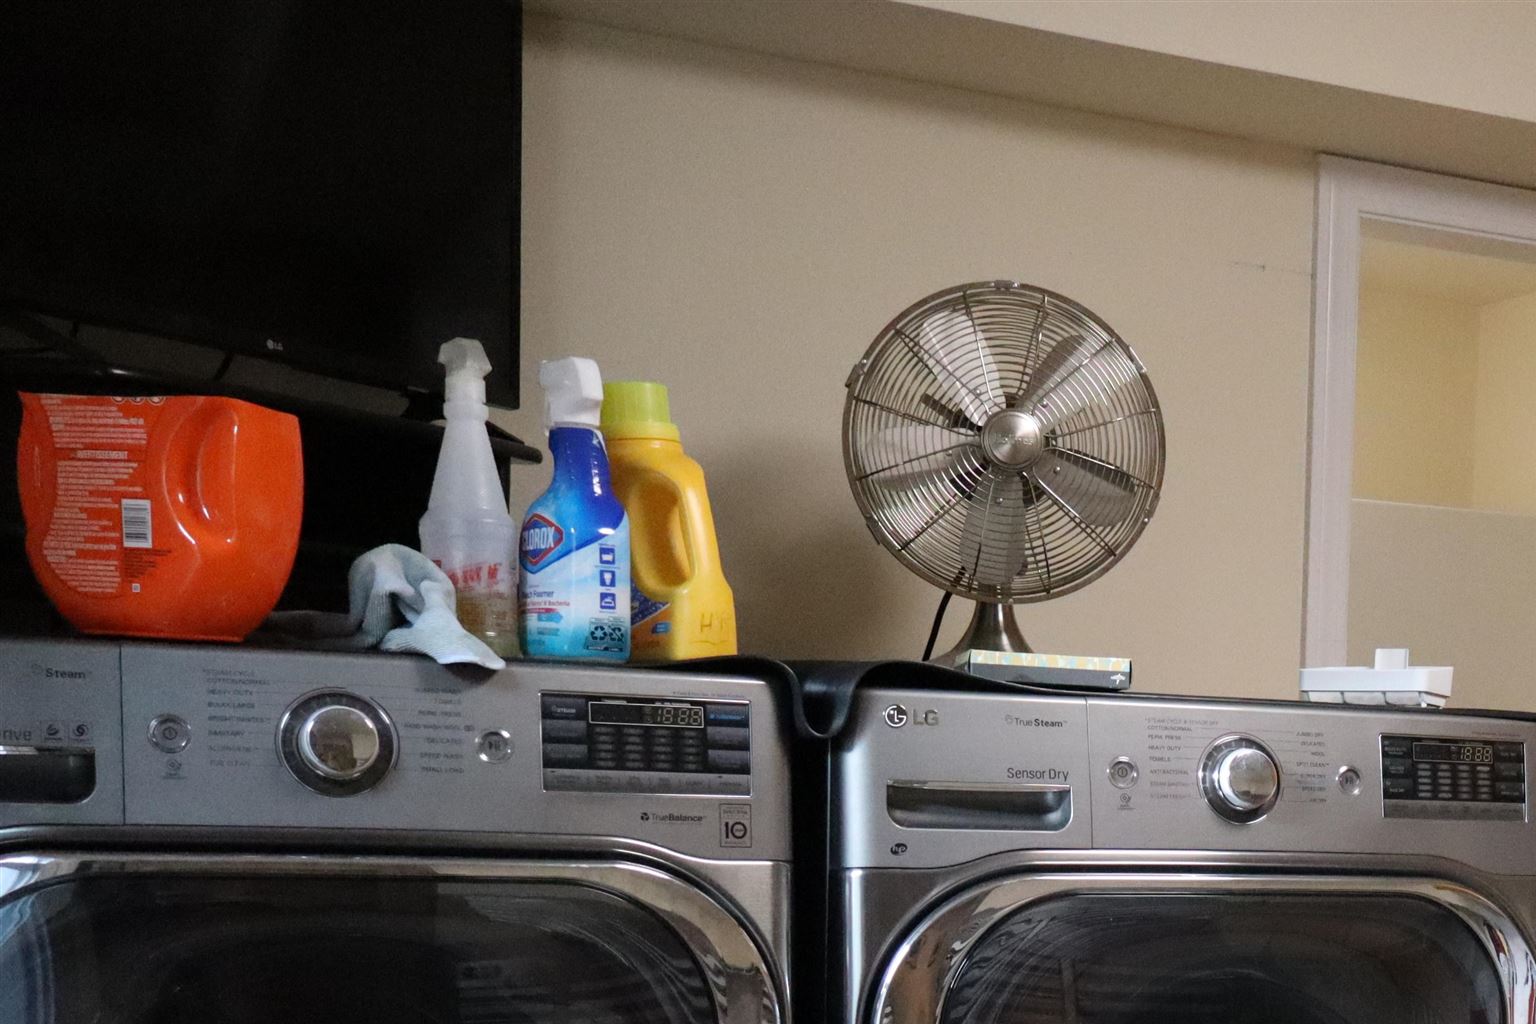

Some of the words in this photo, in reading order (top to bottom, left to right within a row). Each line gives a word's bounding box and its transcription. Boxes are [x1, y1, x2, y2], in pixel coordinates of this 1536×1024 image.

[912, 708, 939, 726] LG
[1007, 767, 1046, 780] Sensor
[1048, 768, 1070, 783] Dry
